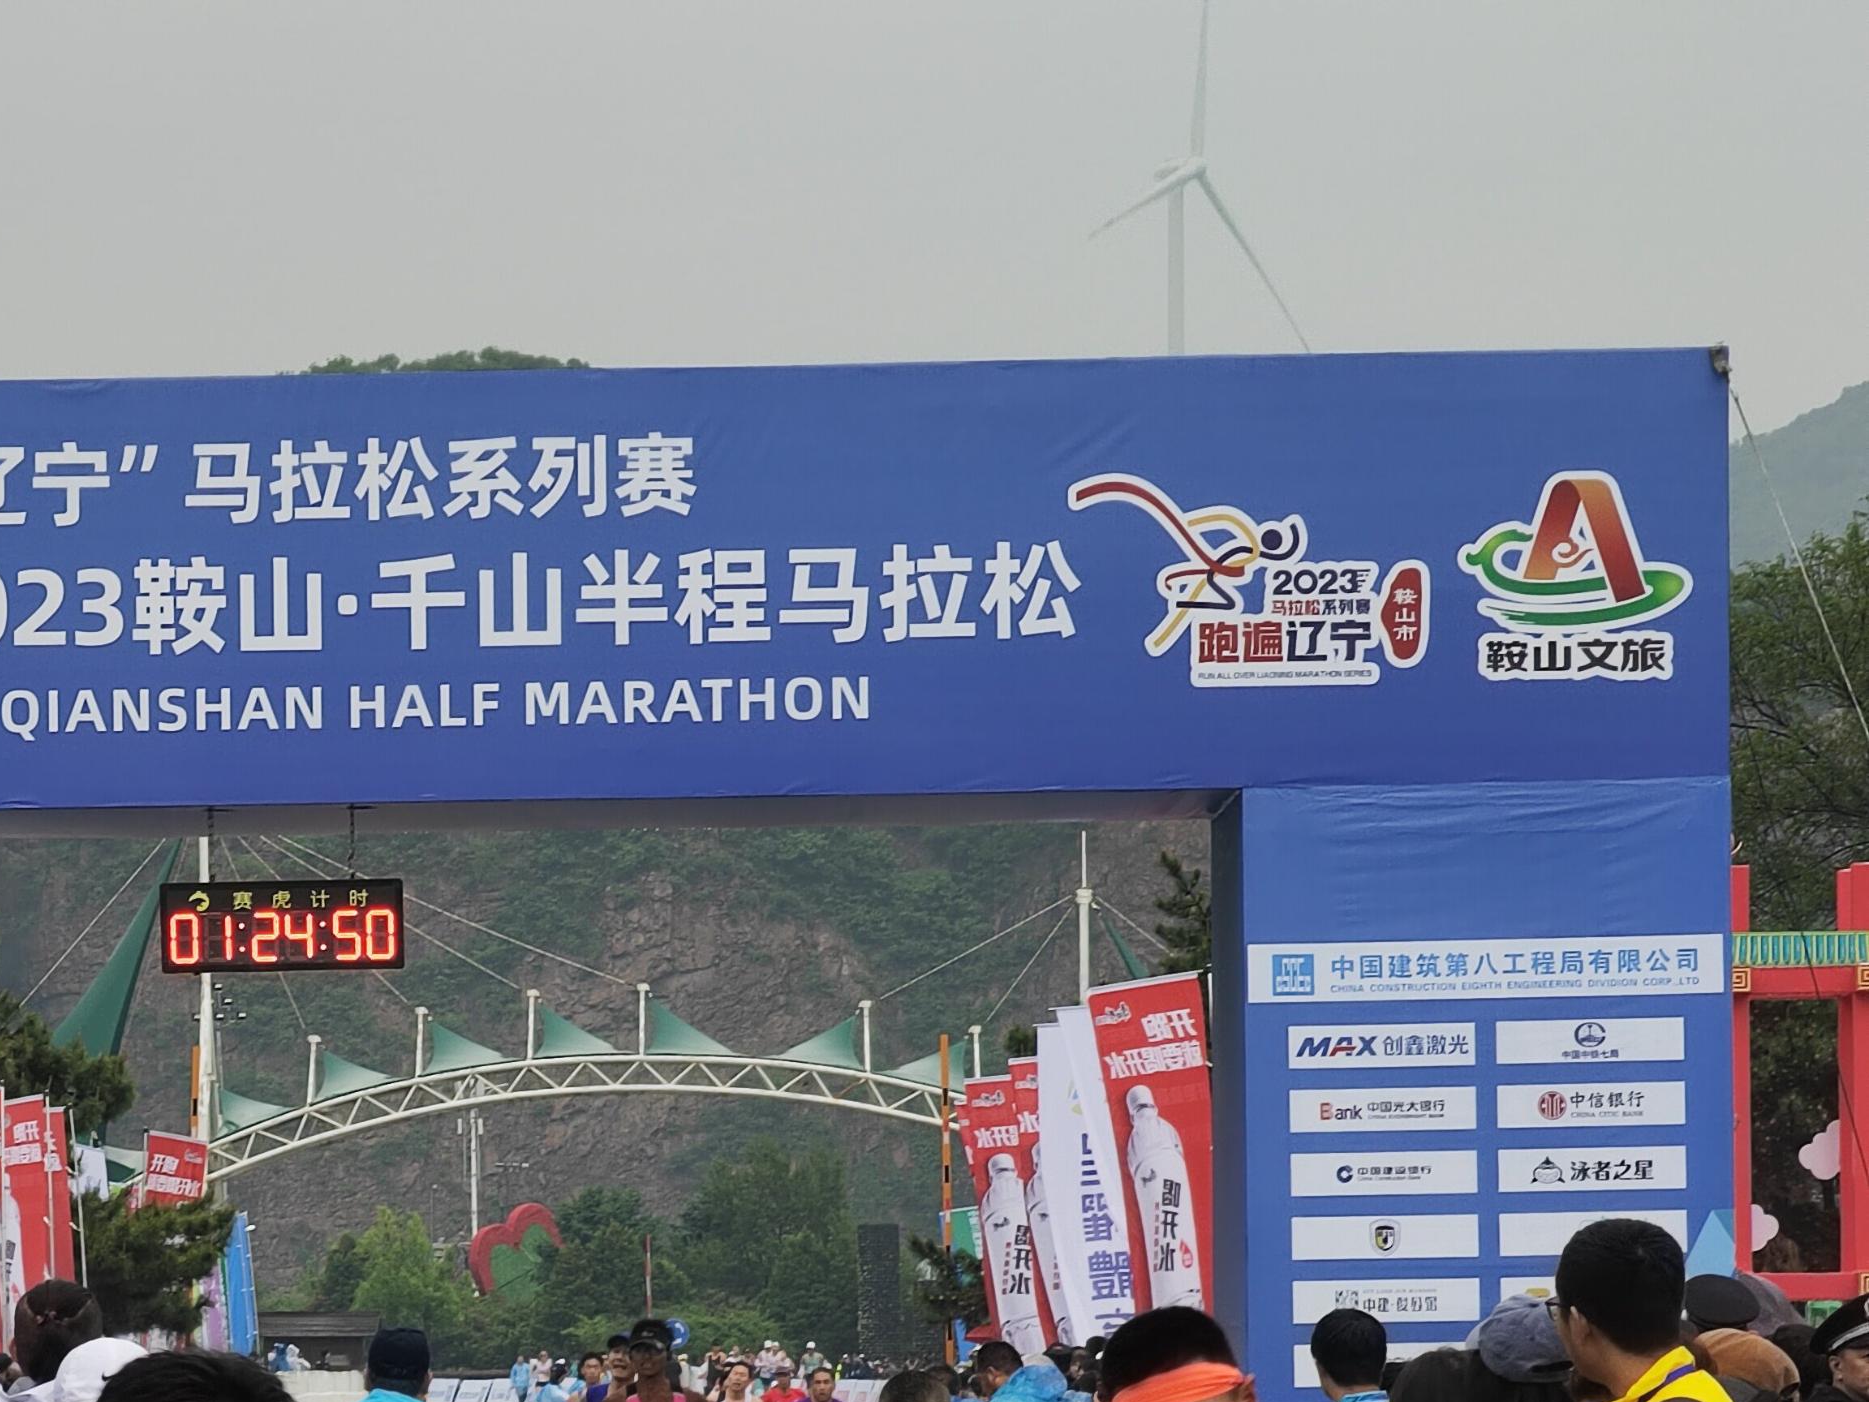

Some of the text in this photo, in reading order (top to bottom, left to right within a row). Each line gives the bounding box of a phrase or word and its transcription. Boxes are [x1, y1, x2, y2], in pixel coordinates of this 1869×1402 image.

[183, 431, 698, 525] 马拉松系列赛
[1272, 567, 1365, 596] 2023
[1271, 599, 1372, 616] 马拉松系列赛
[1392, 587, 1419, 642] 鞍山市
[1197, 619, 1372, 663] 跑遍辽宁
[1486, 638, 1666, 672] 鞍山文旅
[1234, 670, 1256, 678] OVER
[1295, 670, 1343, 678] MARATHON
[1344, 669, 1372, 677] SERIES
[0, 685, 324, 741] QIANSHAN
[348, 682, 501, 729] HALF
[525, 675, 871, 726] MARATHON
[233, 889, 369, 910] 赛虎计时
[169, 908, 396, 965] 01:24:50
[1330, 948, 1699, 980] 中国建筑第八工程局有限公司
[1330, 984, 1364, 994] CHINA
[1369, 983, 1457, 993] CONSTRUCTION
[1461, 981, 1502, 991] EIGHTH
[1507, 980, 1582, 989] ENGINEERING
[1295, 1034, 1469, 1058] MAX 创鑫激光
[1320, 1102, 1363, 1121] Bank
[1569, 1091, 1645, 1109] 中信银行
[1570, 1159, 1655, 1181] 泳者之星
